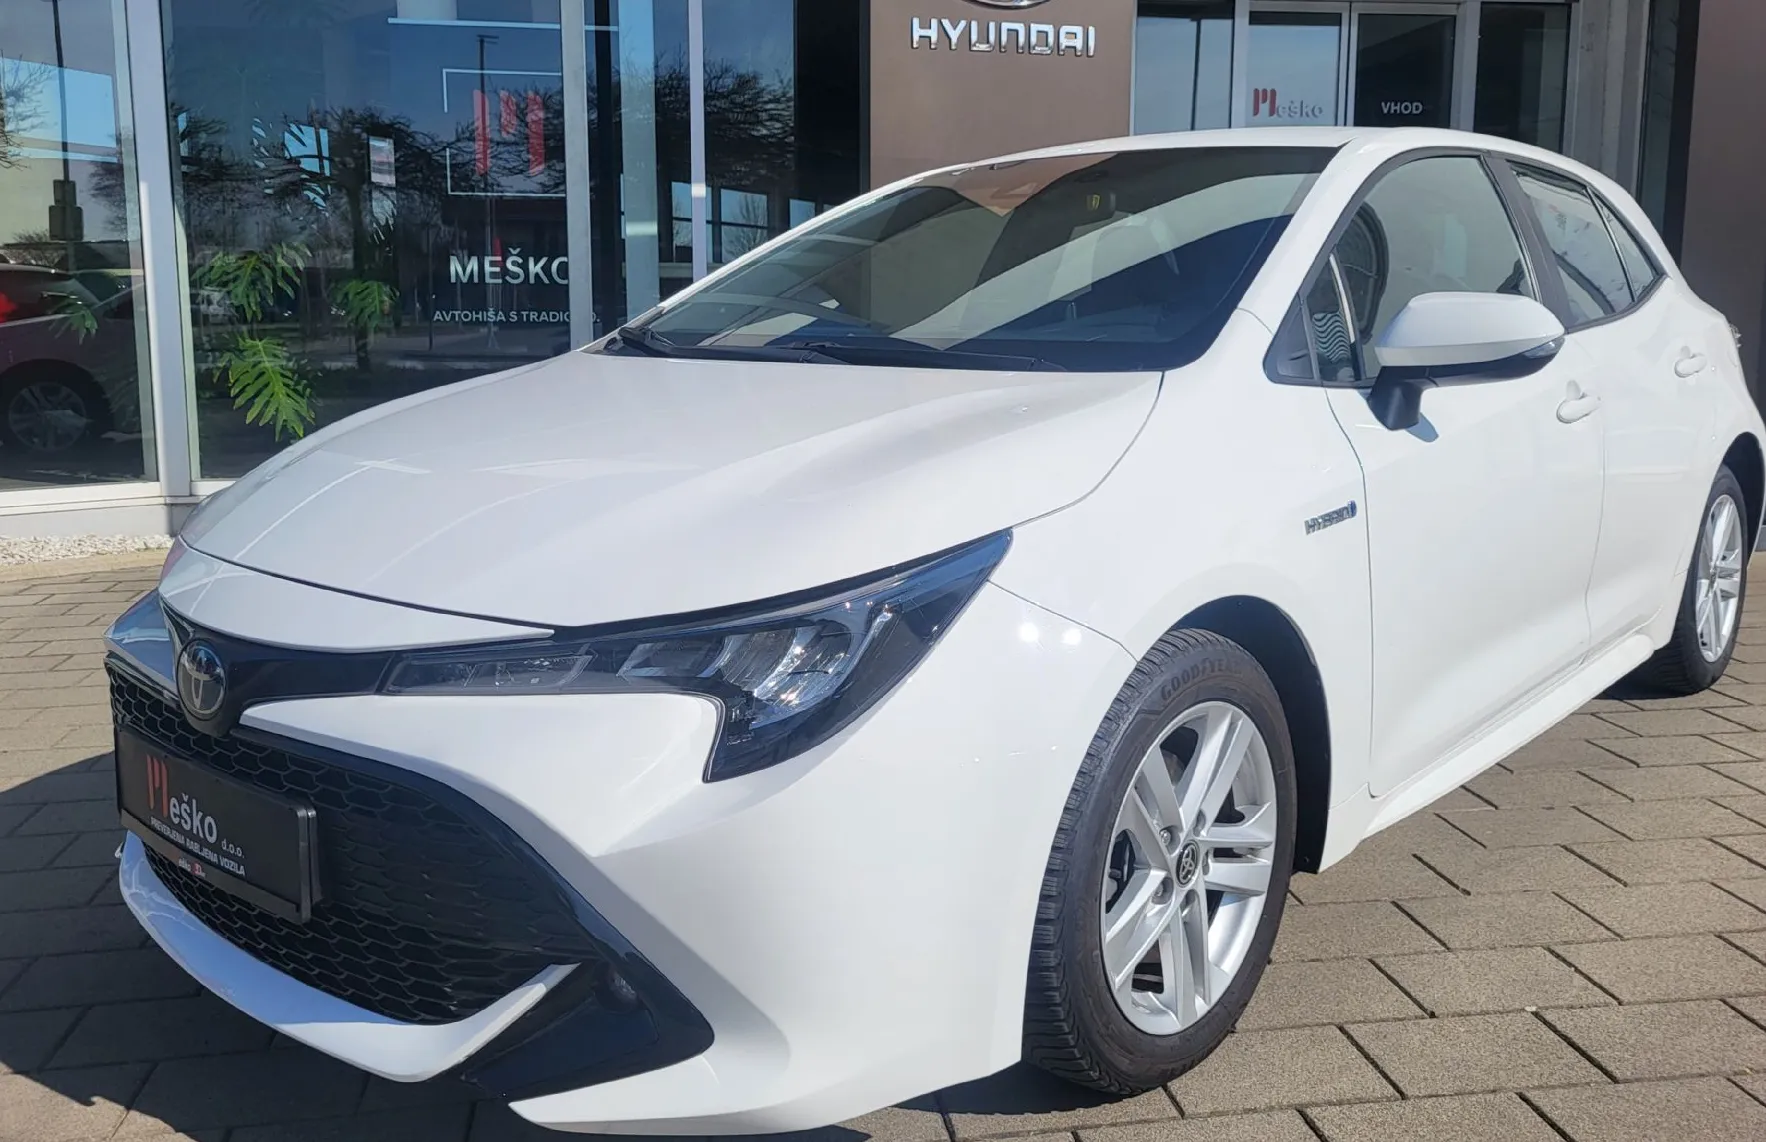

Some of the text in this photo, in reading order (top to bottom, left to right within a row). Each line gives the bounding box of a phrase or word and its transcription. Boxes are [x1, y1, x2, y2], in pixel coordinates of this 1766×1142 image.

[911, 16, 1096, 58] HYUNDAI
[1381, 101, 1424, 115] VHOD
[433, 307, 506, 322] AVTOHIŠA
[509, 311, 518, 322] S
[1304, 505, 1351, 535] HYBRID
[186, 838, 218, 864] RABLJENA
[219, 855, 246, 876] VOZILA
[221, 838, 245, 859] d.o.o.
